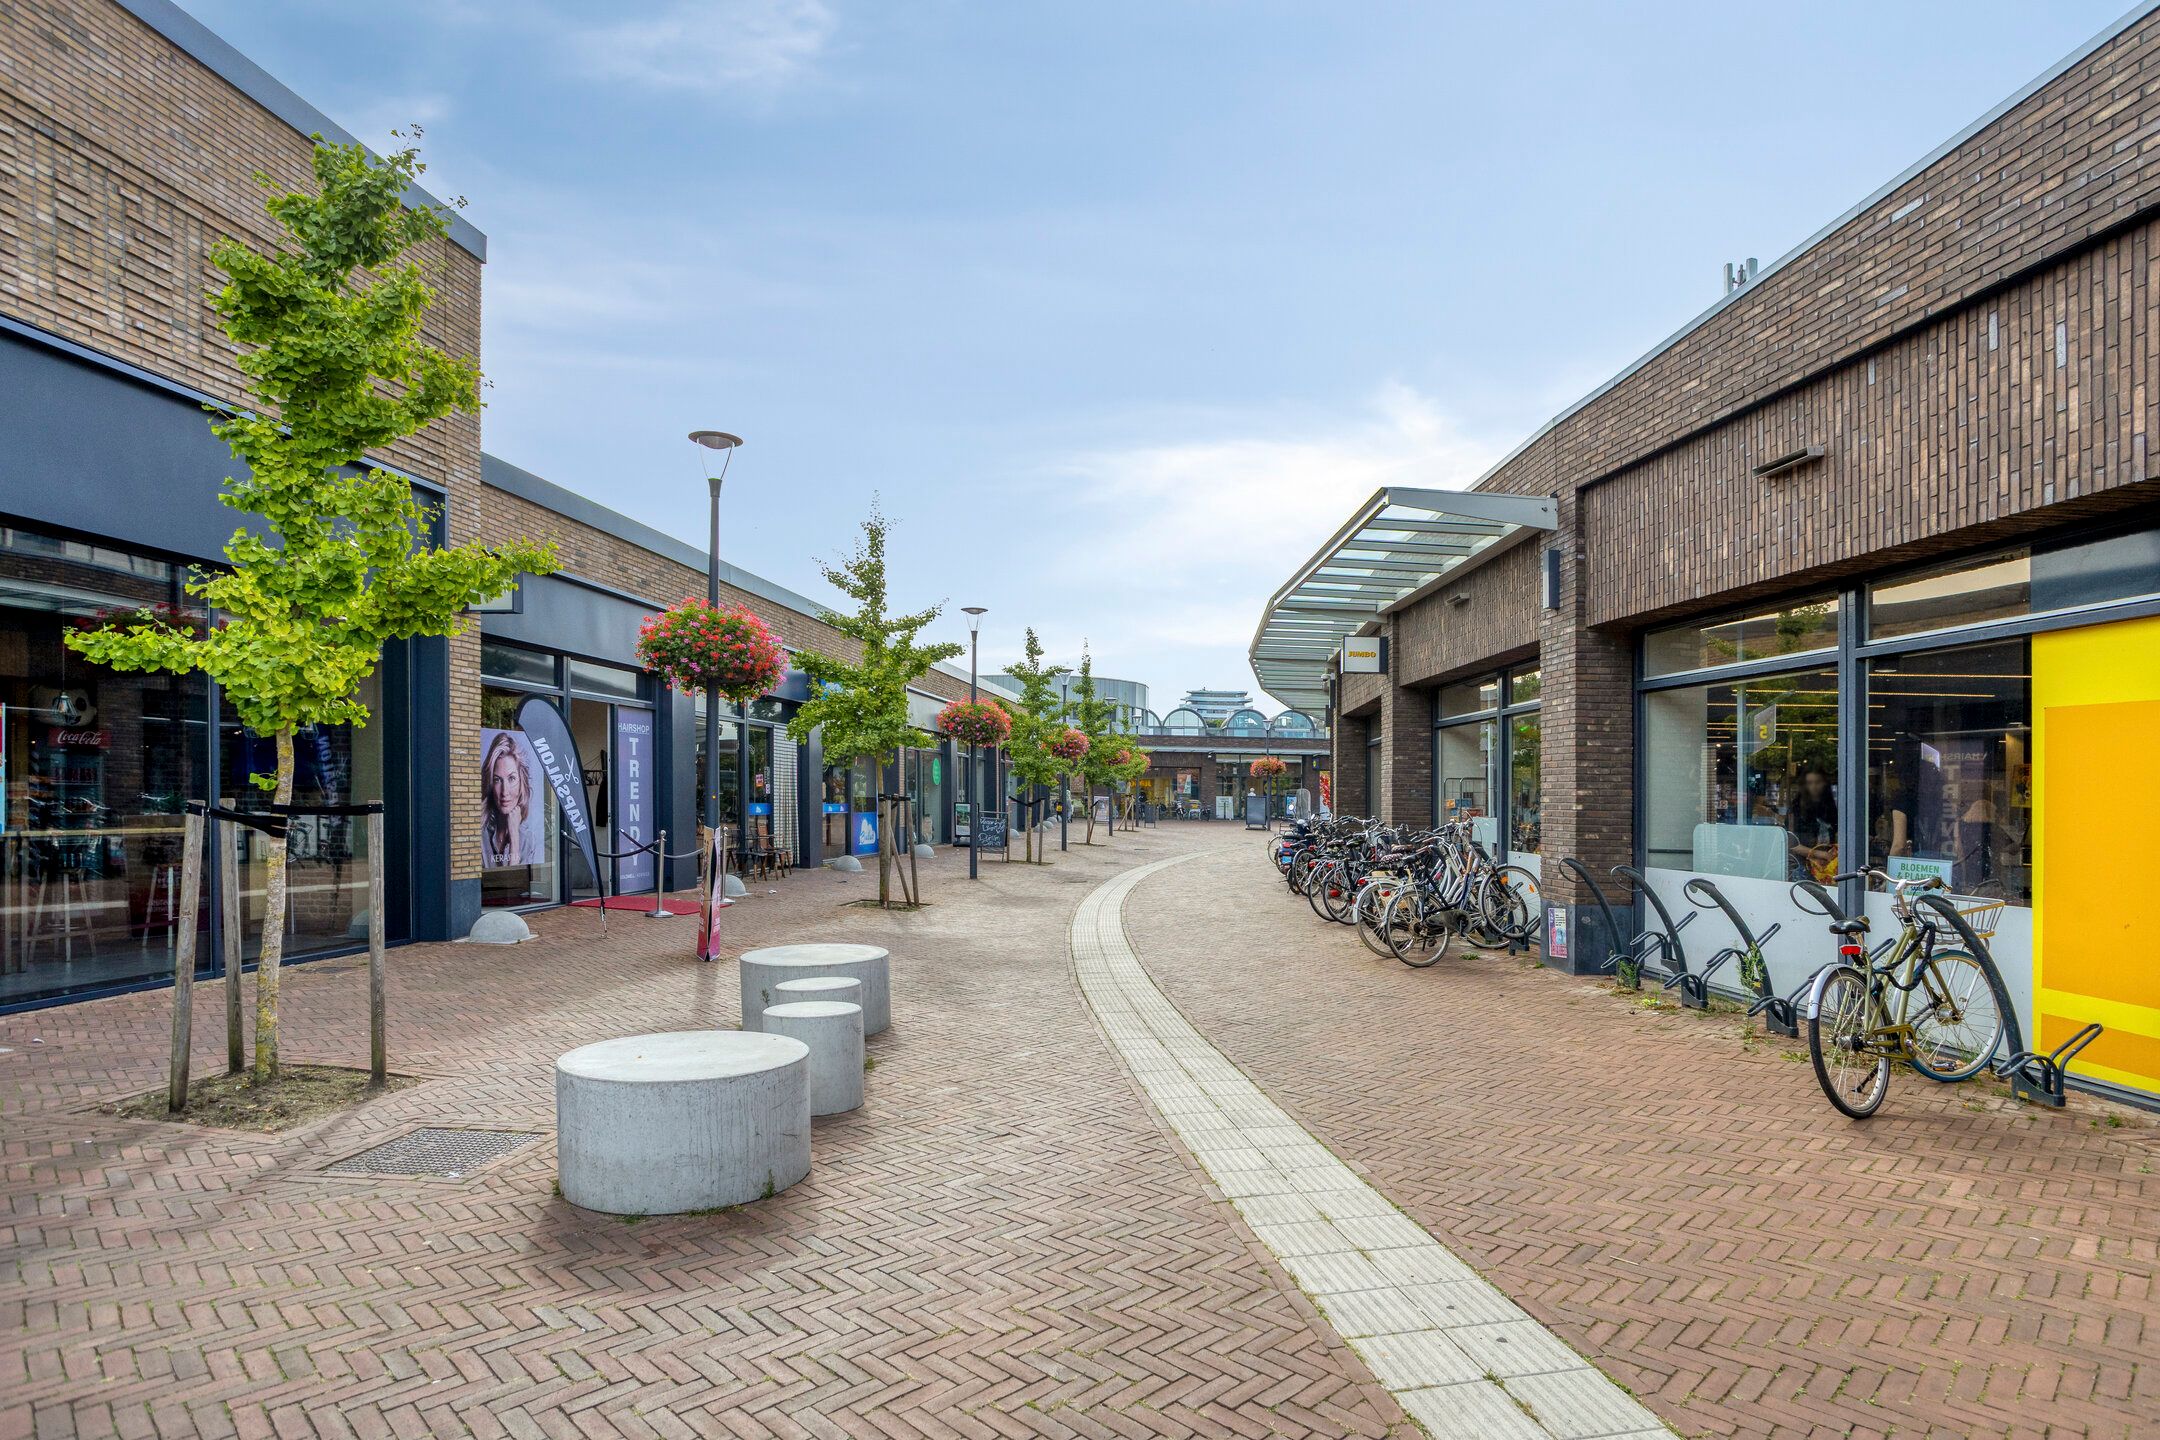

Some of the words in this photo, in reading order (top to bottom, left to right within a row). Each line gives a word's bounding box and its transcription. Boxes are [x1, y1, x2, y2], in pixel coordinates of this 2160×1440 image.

[618, 723, 650, 733] HAIRSHOP
[629, 737, 641, 866] TRENDY
[1901, 863, 1940, 874] BLOEMEN
